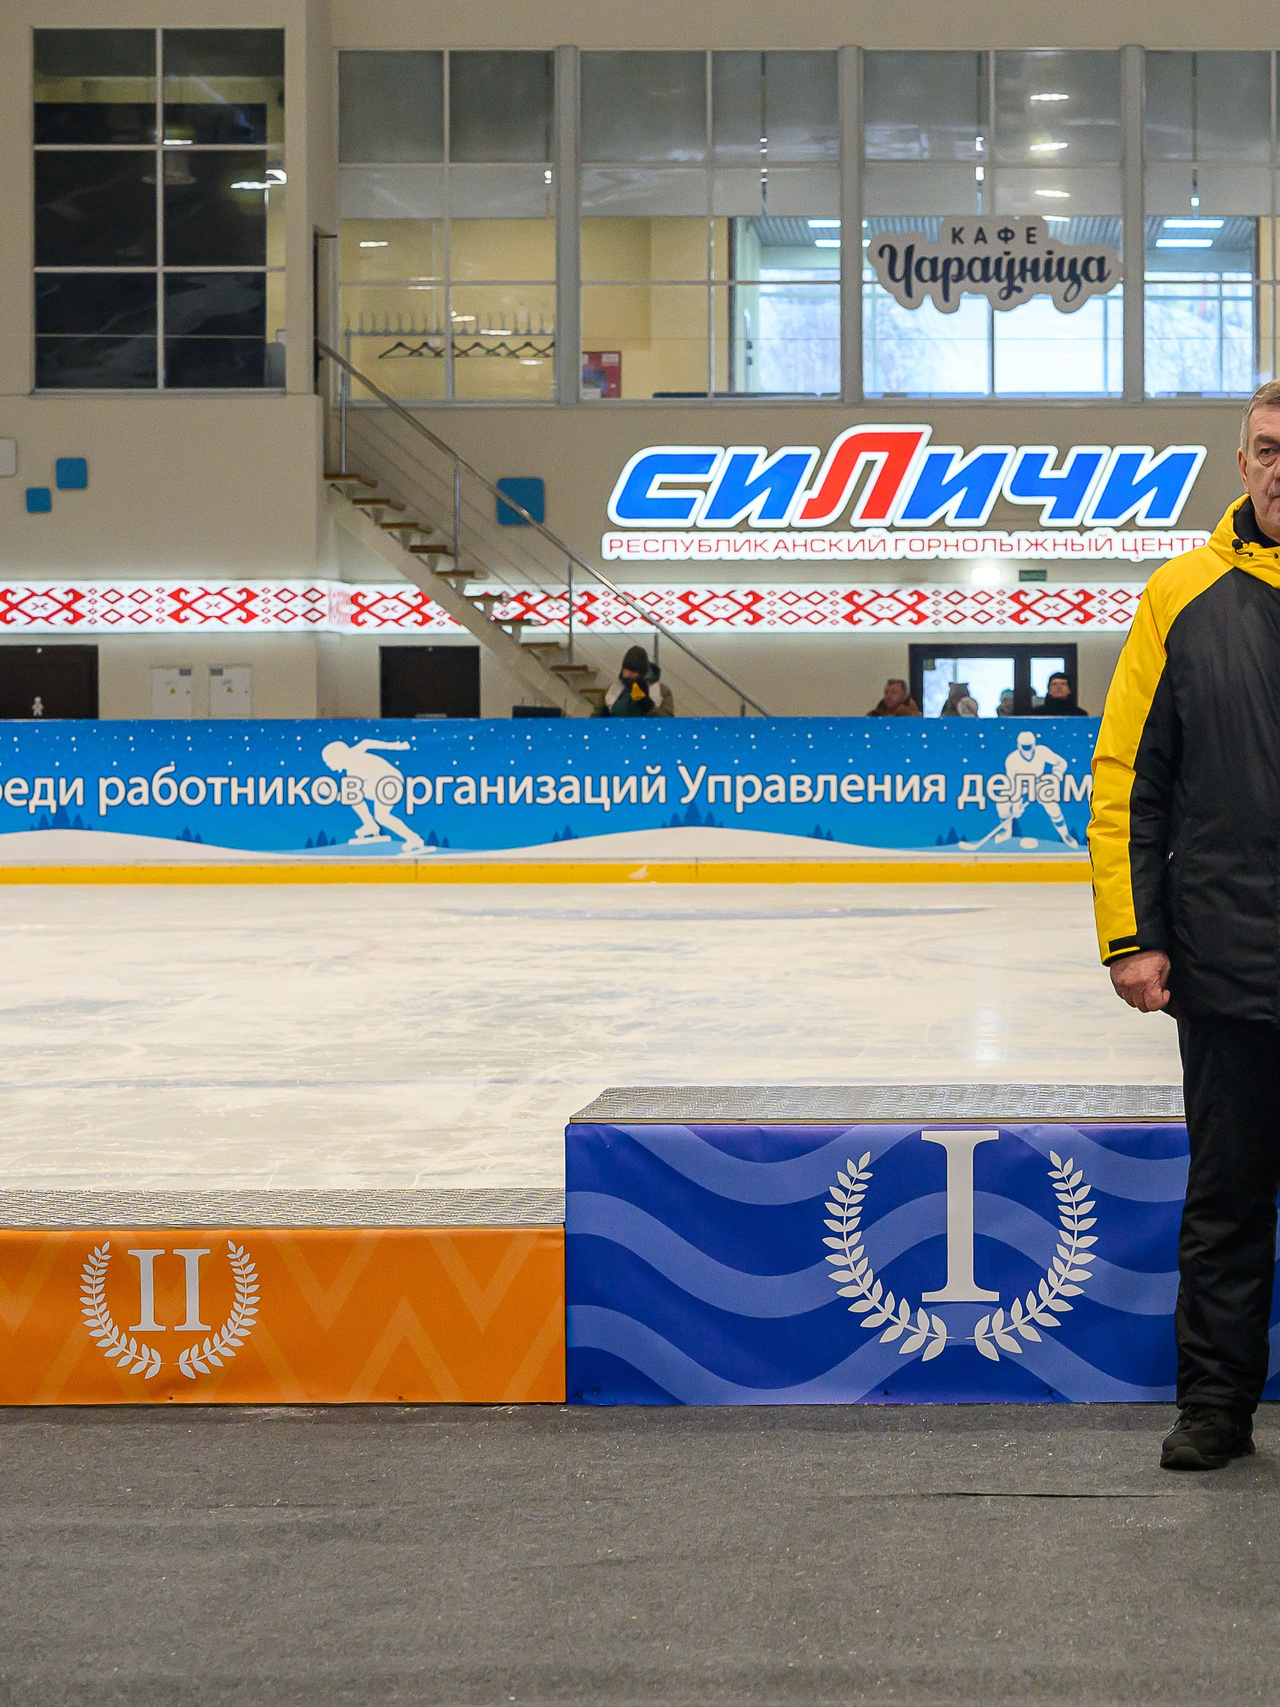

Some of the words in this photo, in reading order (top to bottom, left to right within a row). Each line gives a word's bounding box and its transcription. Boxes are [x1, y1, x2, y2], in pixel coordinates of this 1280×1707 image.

[951, 226, 1039, 245] КАФЕ
[877, 243, 1112, 302] Чараўніца
[608, 533, 887, 553] РЕСПУБЛИКАНСКИЙ
[893, 533, 1114, 552] ГОРНОЛЫЖНЫЙ
[1121, 536, 1207, 555] ЦЕНТР
[0, 775, 85, 815] еди
[98, 765, 366, 817] работников
[375, 764, 667, 816] организаций
[677, 764, 947, 814] Управления
[921, 1130, 1000, 1302] I
[127, 1248, 212, 1332] II
